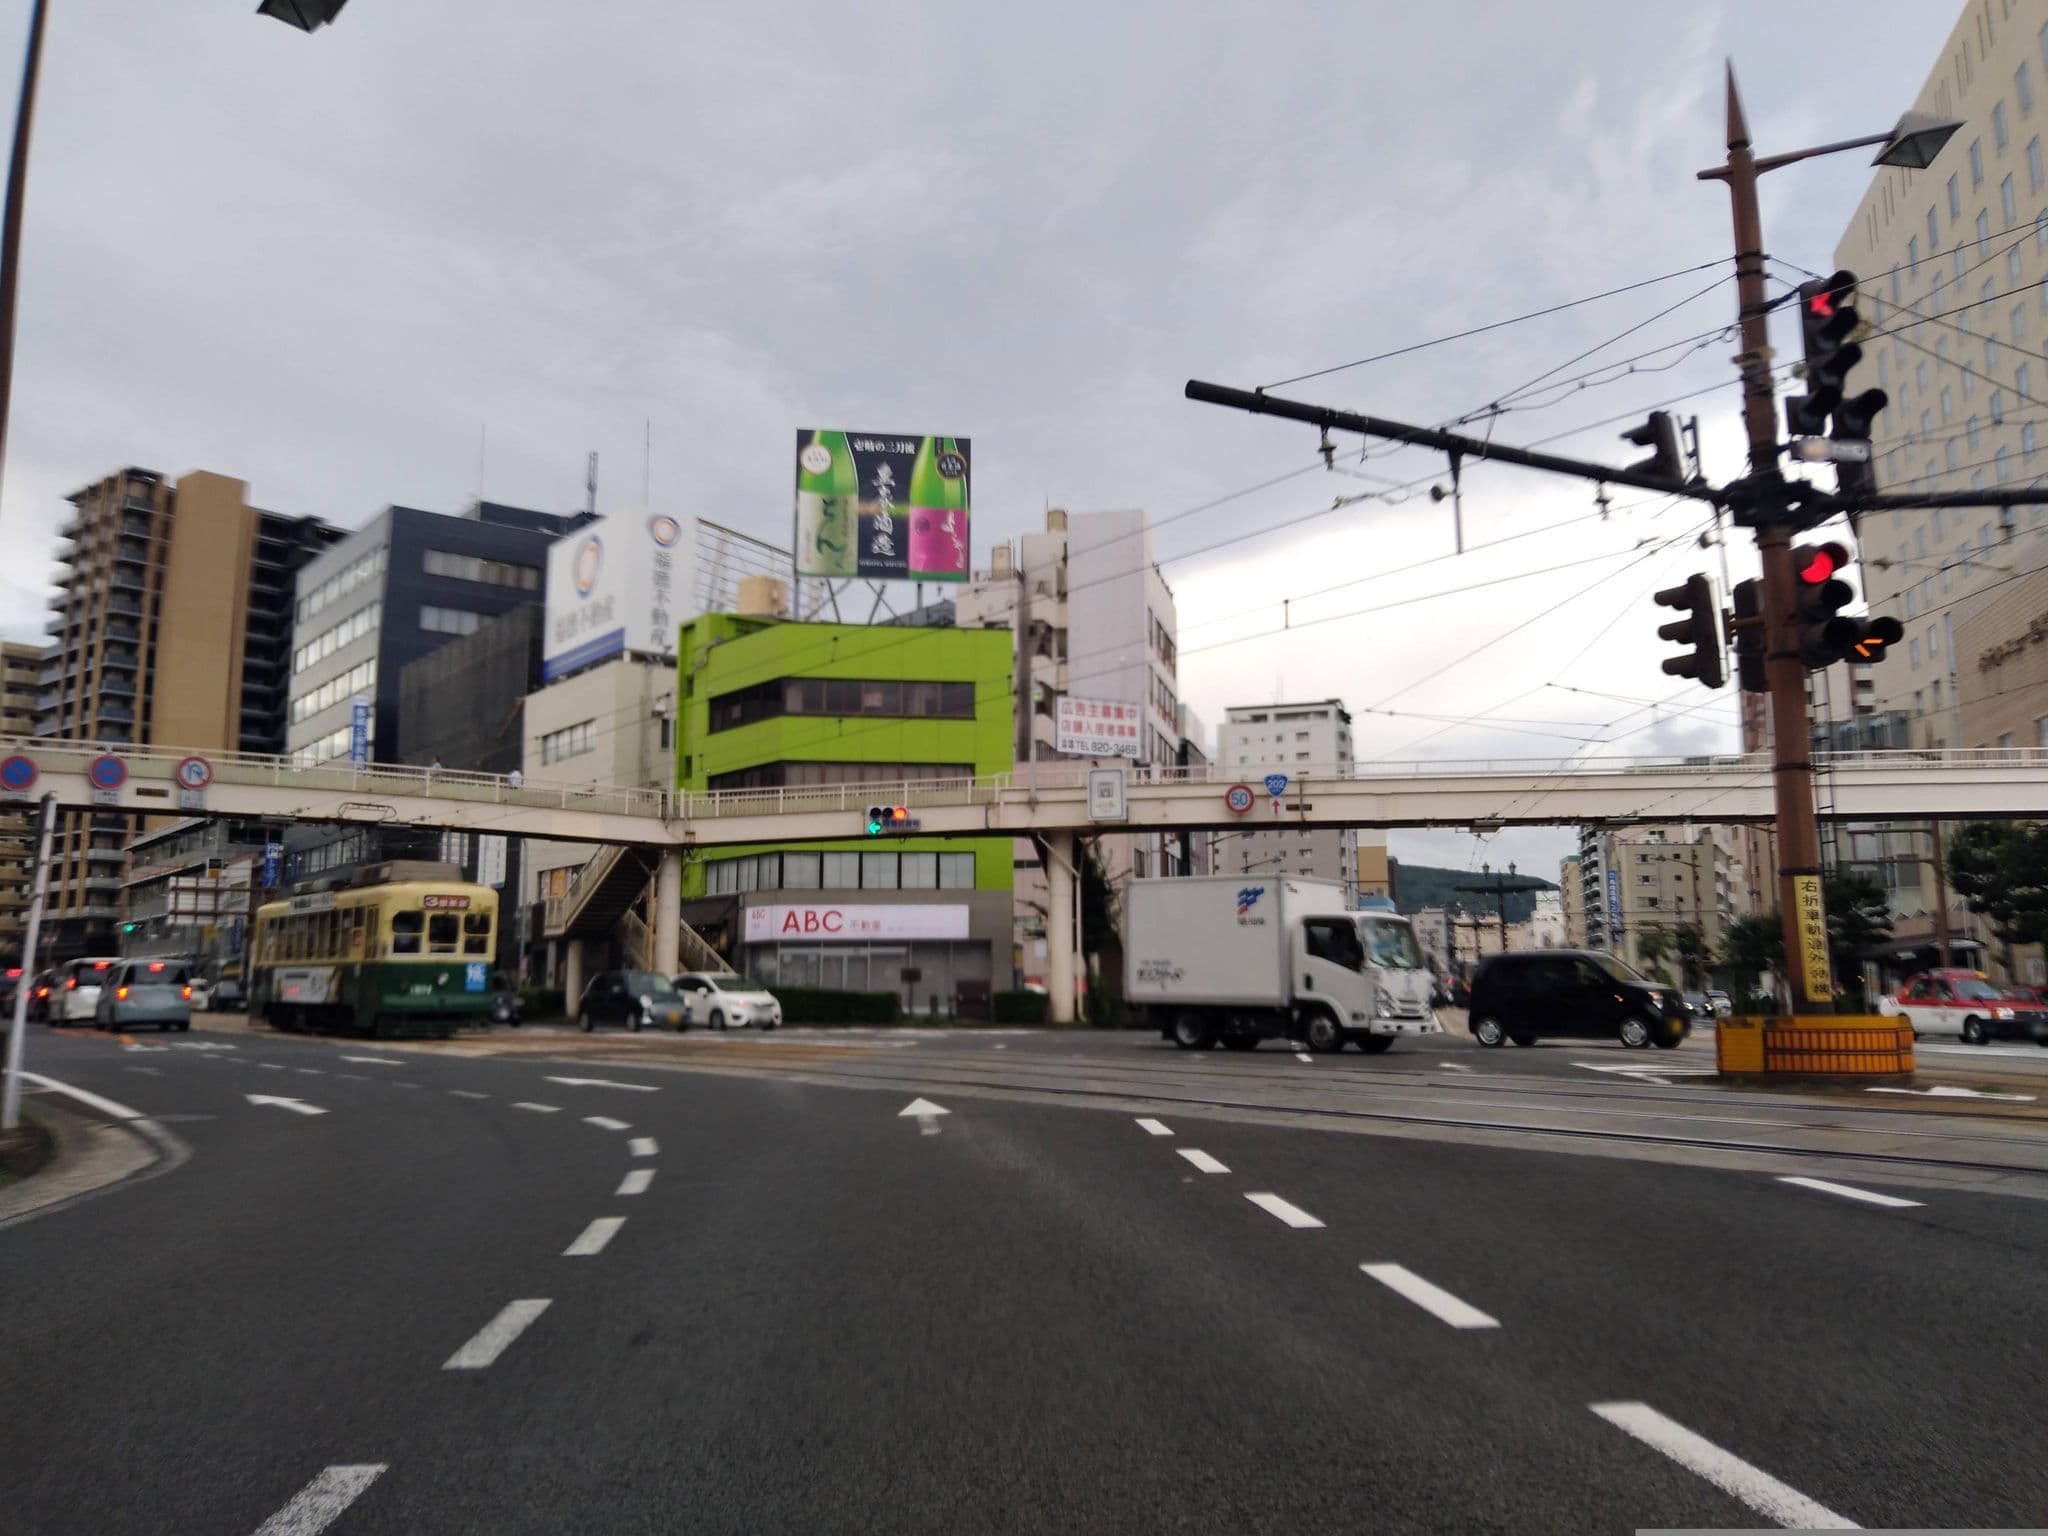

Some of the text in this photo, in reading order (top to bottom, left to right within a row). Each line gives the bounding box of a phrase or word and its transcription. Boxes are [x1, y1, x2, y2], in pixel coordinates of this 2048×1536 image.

[1062, 702, 1136, 720] 広告主募集中
[1267, 780, 1285, 790] 202
[1231, 791, 1249, 807] 50
[782, 910, 843, 933] ABC
